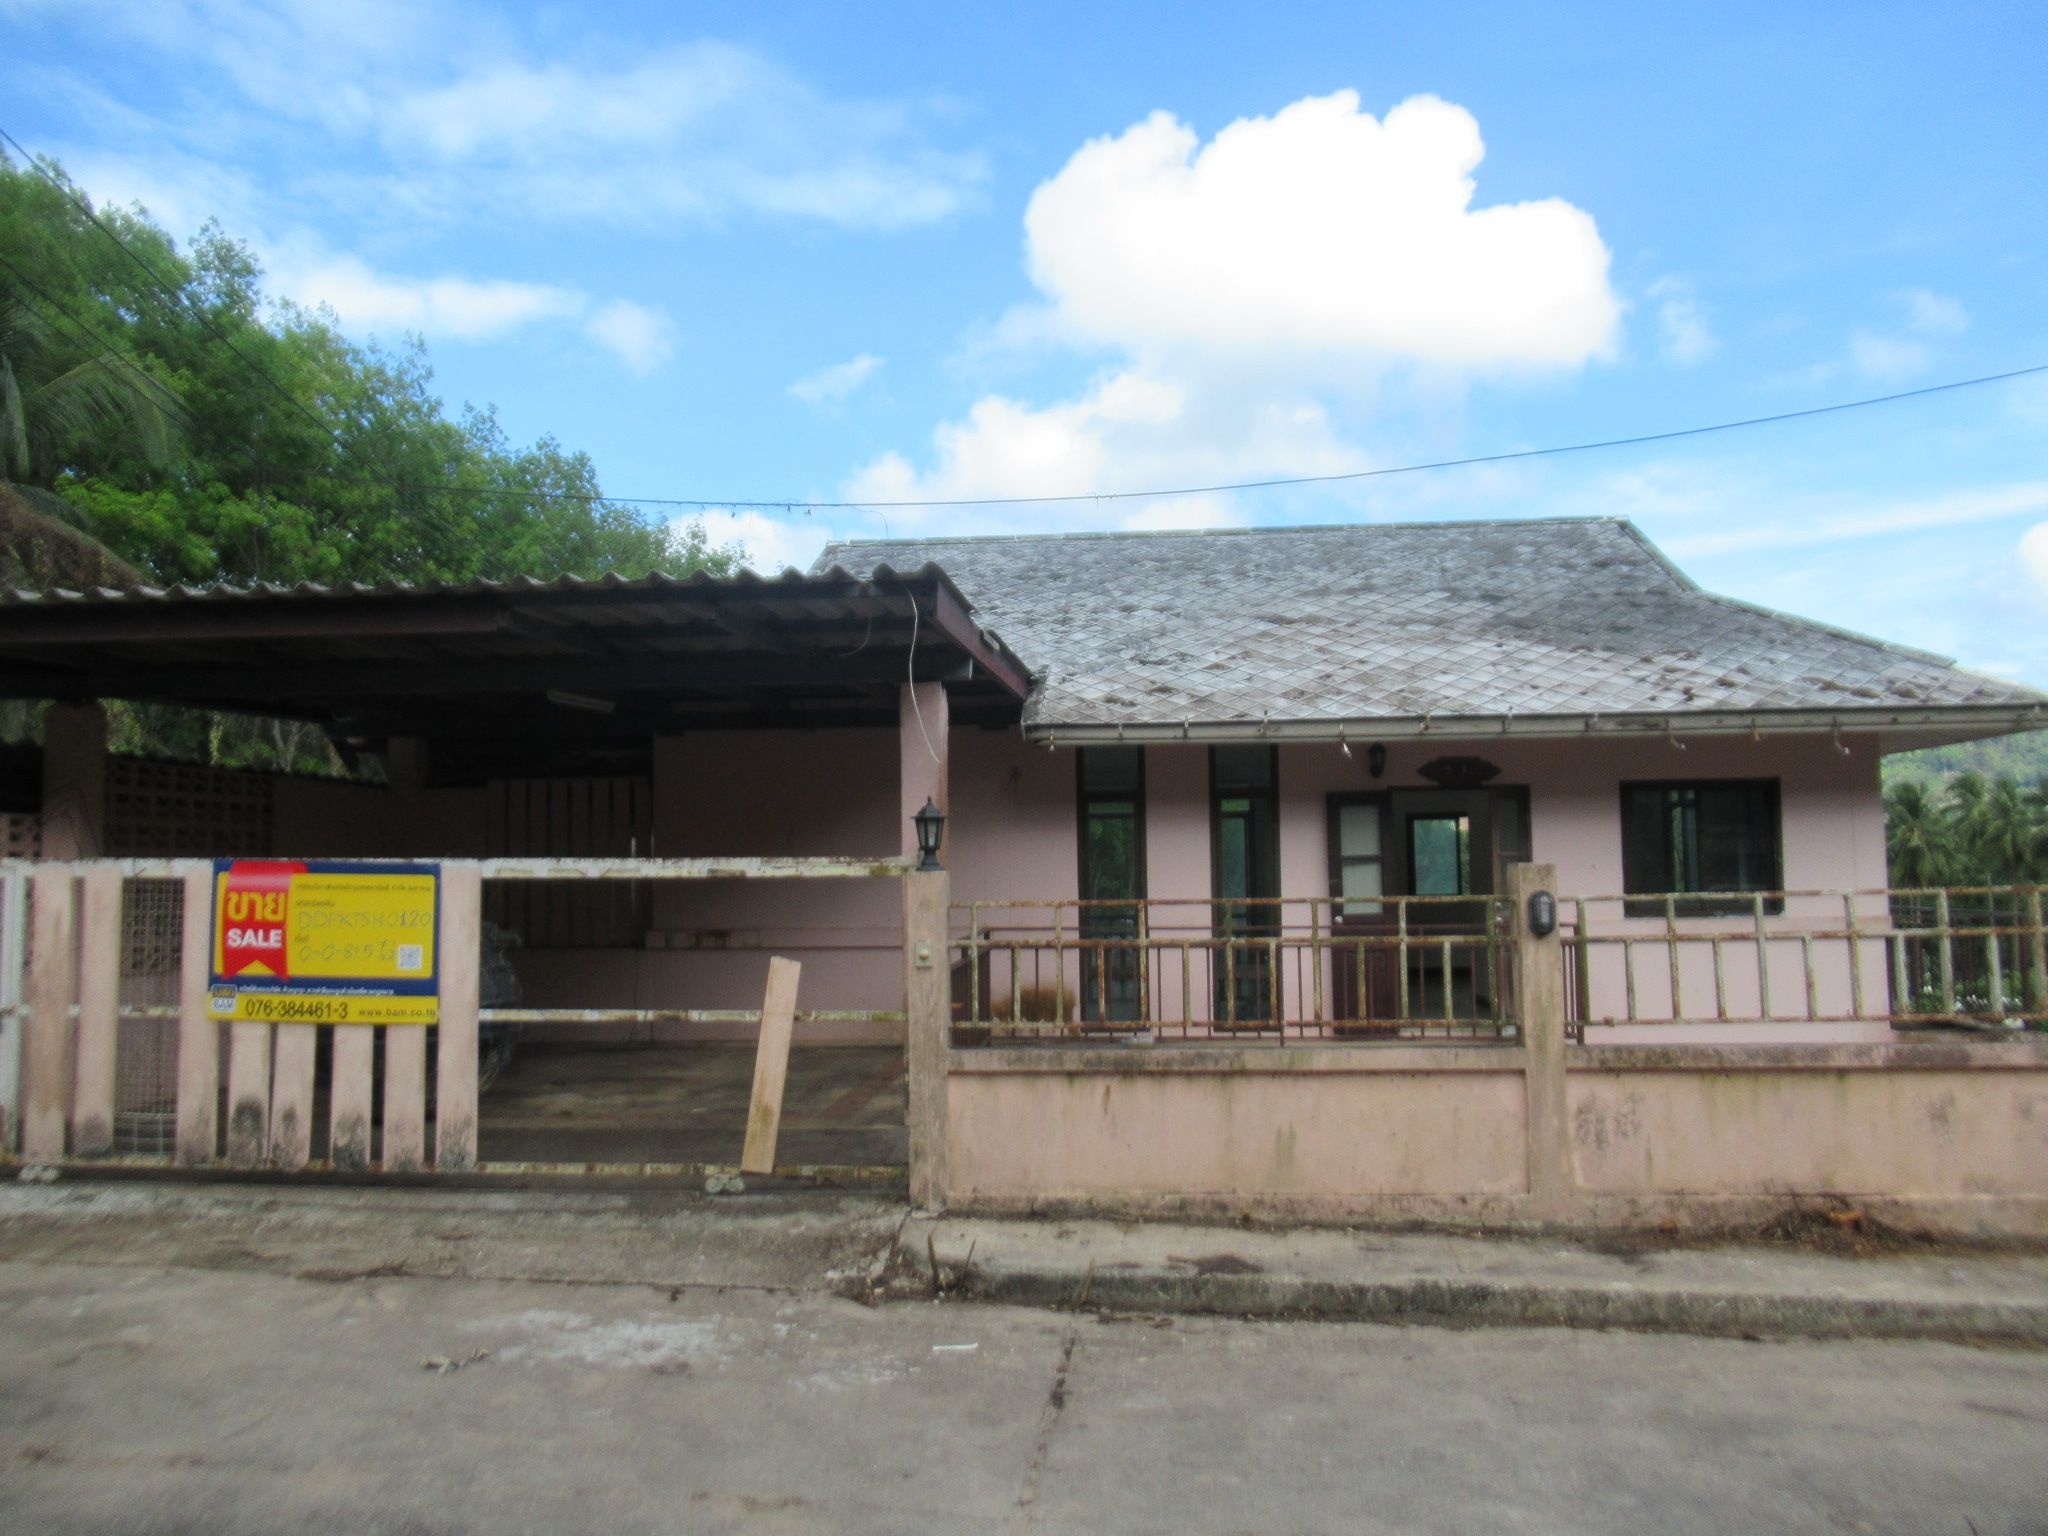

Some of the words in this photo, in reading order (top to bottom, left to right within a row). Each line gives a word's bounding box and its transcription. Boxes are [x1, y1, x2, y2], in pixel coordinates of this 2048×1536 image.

[227, 890, 286, 921] ขาย
[227, 929, 282, 947] SALE
[246, 998, 348, 1019] 076-384461-3
